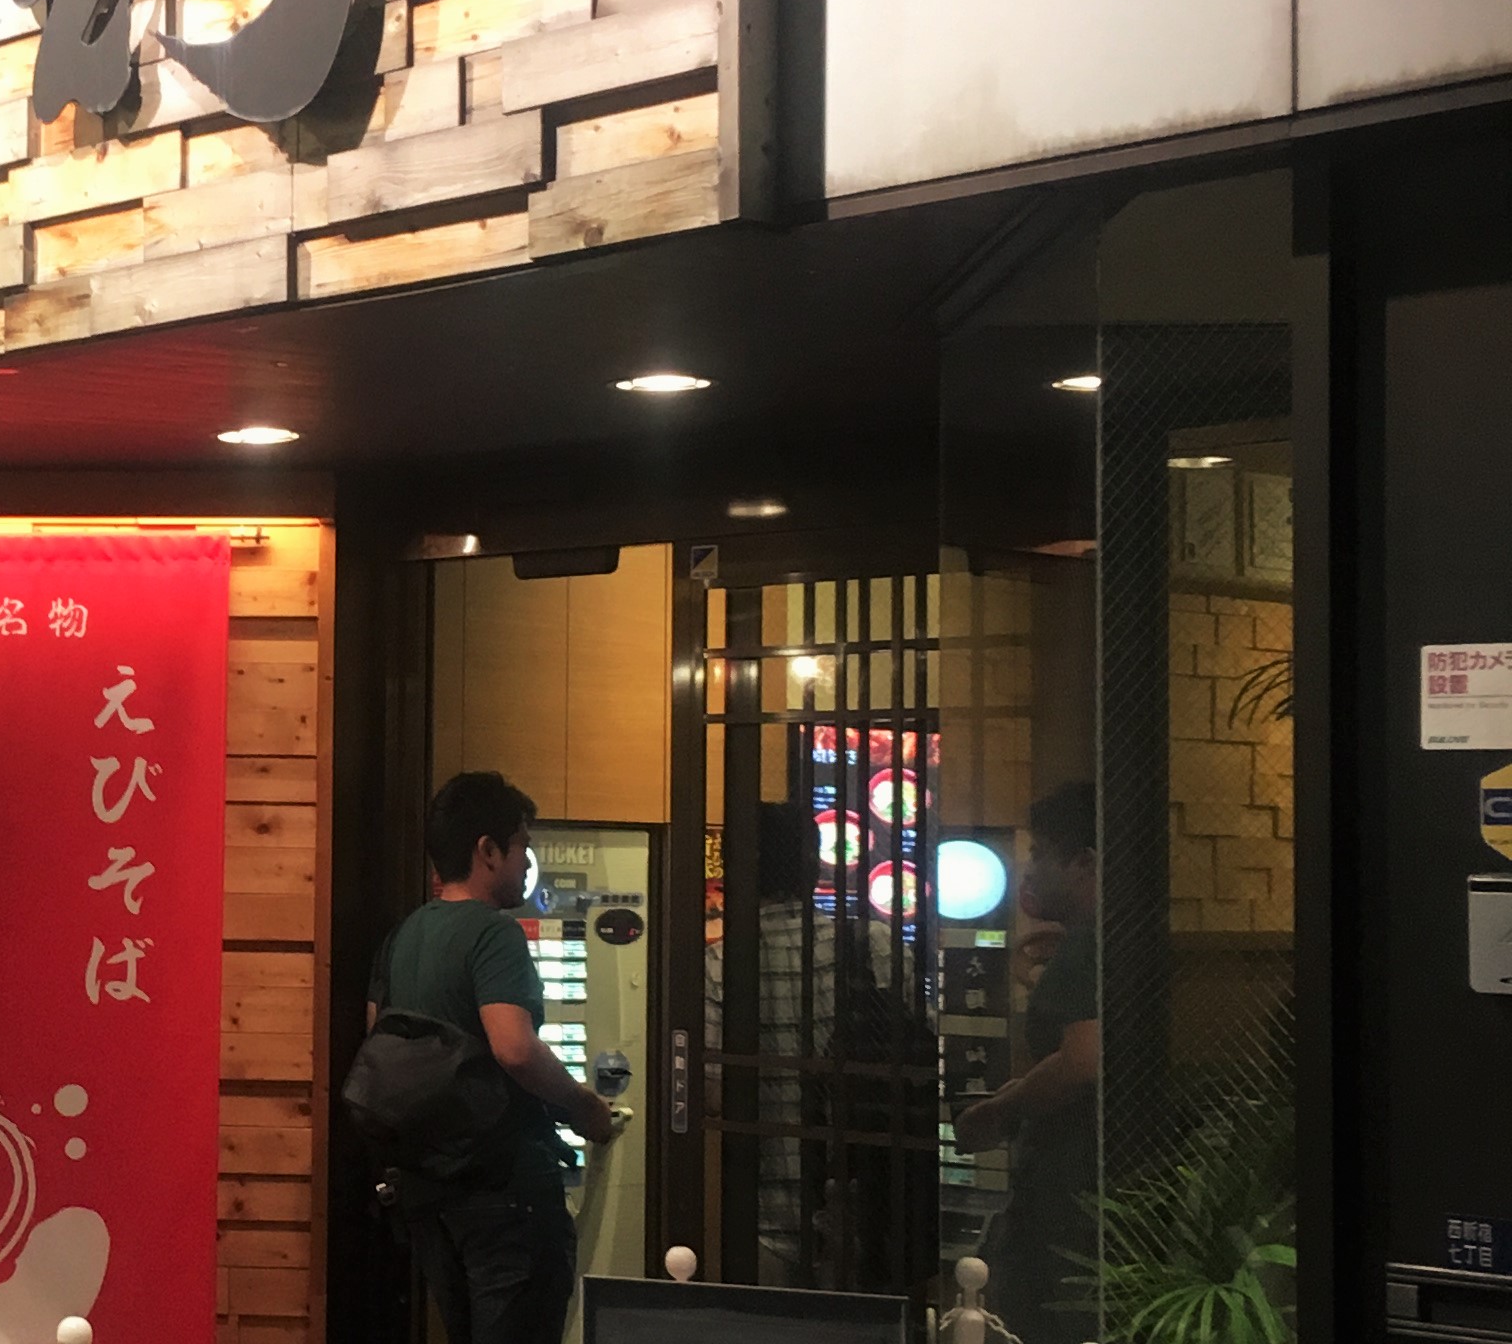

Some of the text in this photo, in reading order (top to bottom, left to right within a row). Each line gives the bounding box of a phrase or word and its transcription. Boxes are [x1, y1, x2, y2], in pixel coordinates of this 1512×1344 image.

[1427, 674, 1468, 695] 設置
[85, 665, 162, 1004] えびそば
[539, 842, 596, 865] TICKET
[1447, 1218, 1493, 1243] 西新宿
[1448, 1244, 1493, 1268] 七丁目
